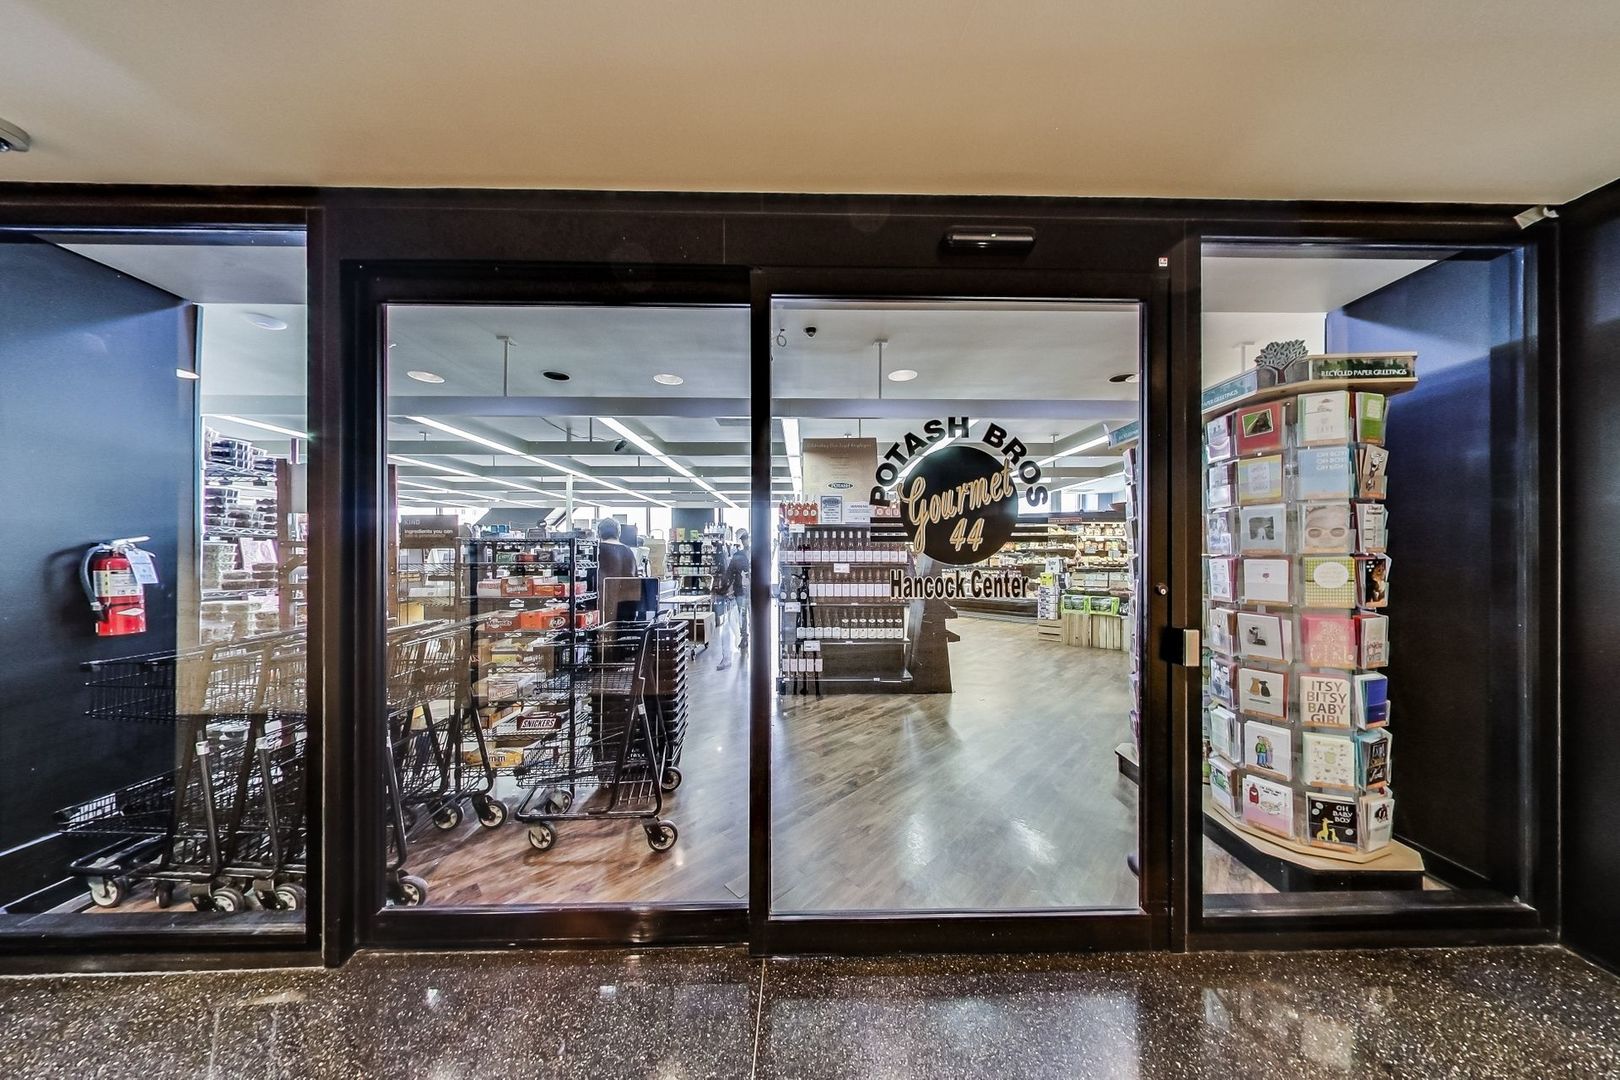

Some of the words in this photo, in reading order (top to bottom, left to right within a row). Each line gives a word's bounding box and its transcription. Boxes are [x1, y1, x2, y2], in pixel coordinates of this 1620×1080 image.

[1373, 368, 1407, 376] GREETINGS
[869, 416, 970, 507] POTASH
[982, 422, 1049, 507] BROS
[897, 457, 1014, 554] Gourmet
[949, 518, 985, 552] 44
[889, 569, 966, 599] Hancock
[970, 569, 1030, 599] Center
[1312, 680, 1343, 692] ITSY
[1307, 691, 1347, 704] BITSY
[1308, 703, 1346, 715] BABY
[521, 718, 556, 728] SNICKERS
